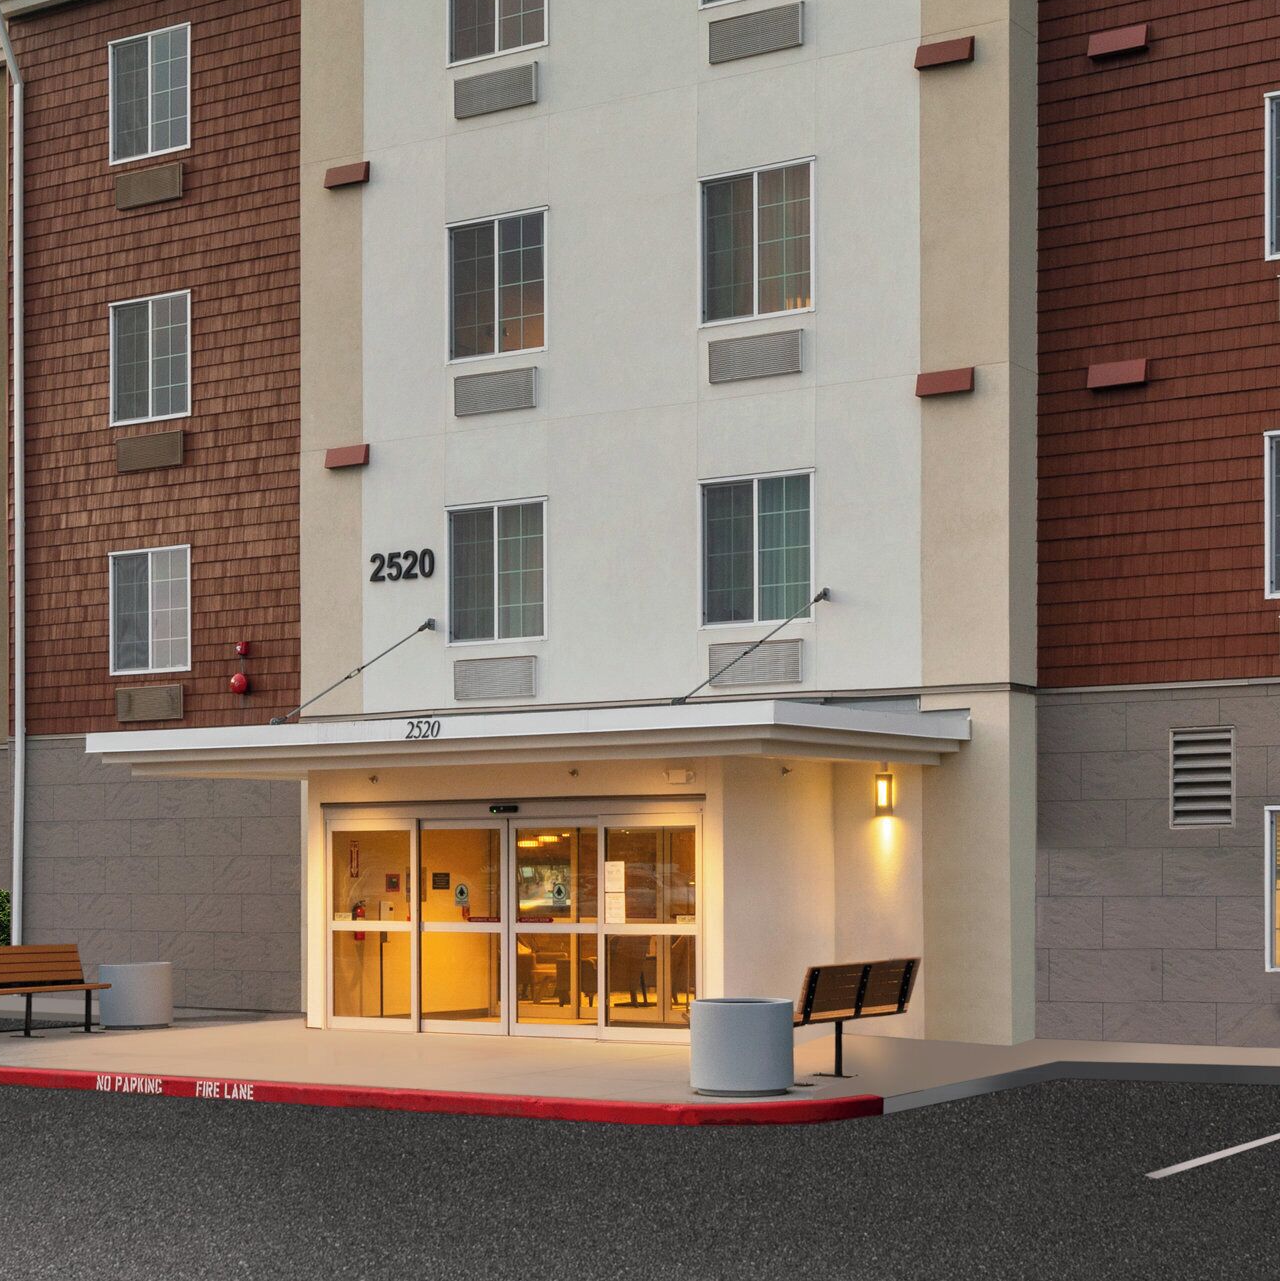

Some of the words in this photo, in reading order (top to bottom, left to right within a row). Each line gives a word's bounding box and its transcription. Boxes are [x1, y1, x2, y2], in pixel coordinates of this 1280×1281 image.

[370, 548, 435, 582] 2520
[405, 720, 441, 740] 2520
[96, 1075, 111, 1092] NO
[115, 1076, 163, 1094] PARKING
[195, 1080, 220, 1098] FIRE
[224, 1082, 254, 1100] LANE
